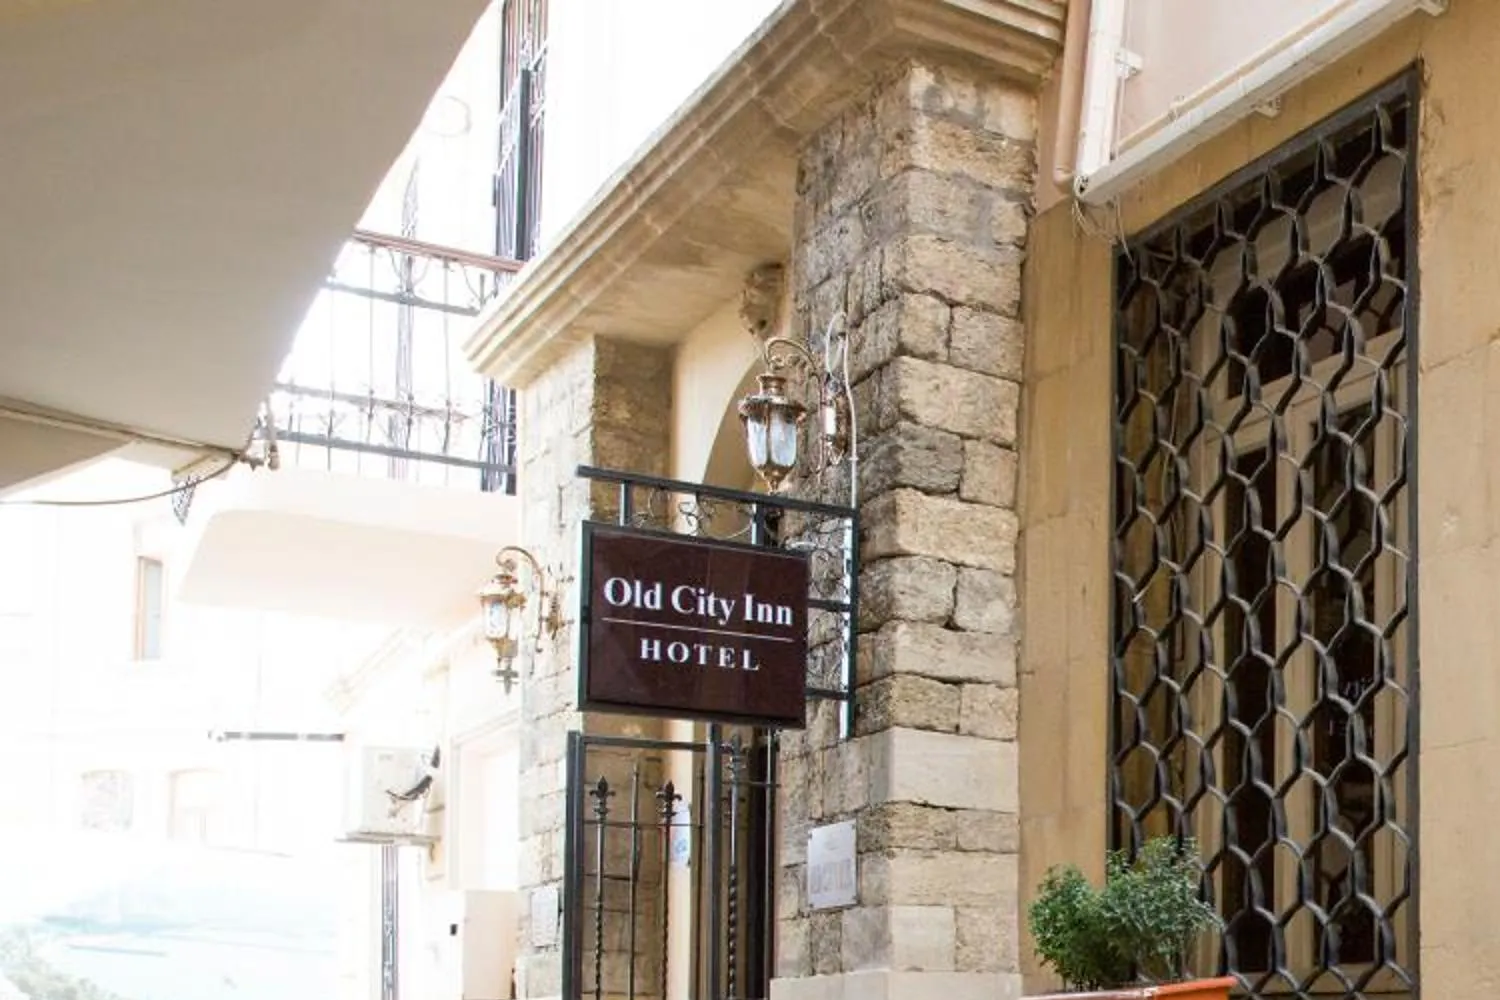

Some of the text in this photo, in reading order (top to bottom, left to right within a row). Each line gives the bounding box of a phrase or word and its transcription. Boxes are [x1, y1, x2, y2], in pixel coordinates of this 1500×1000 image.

[603, 577, 793, 625] Old City Inn
[640, 638, 760, 670] HOTEL
